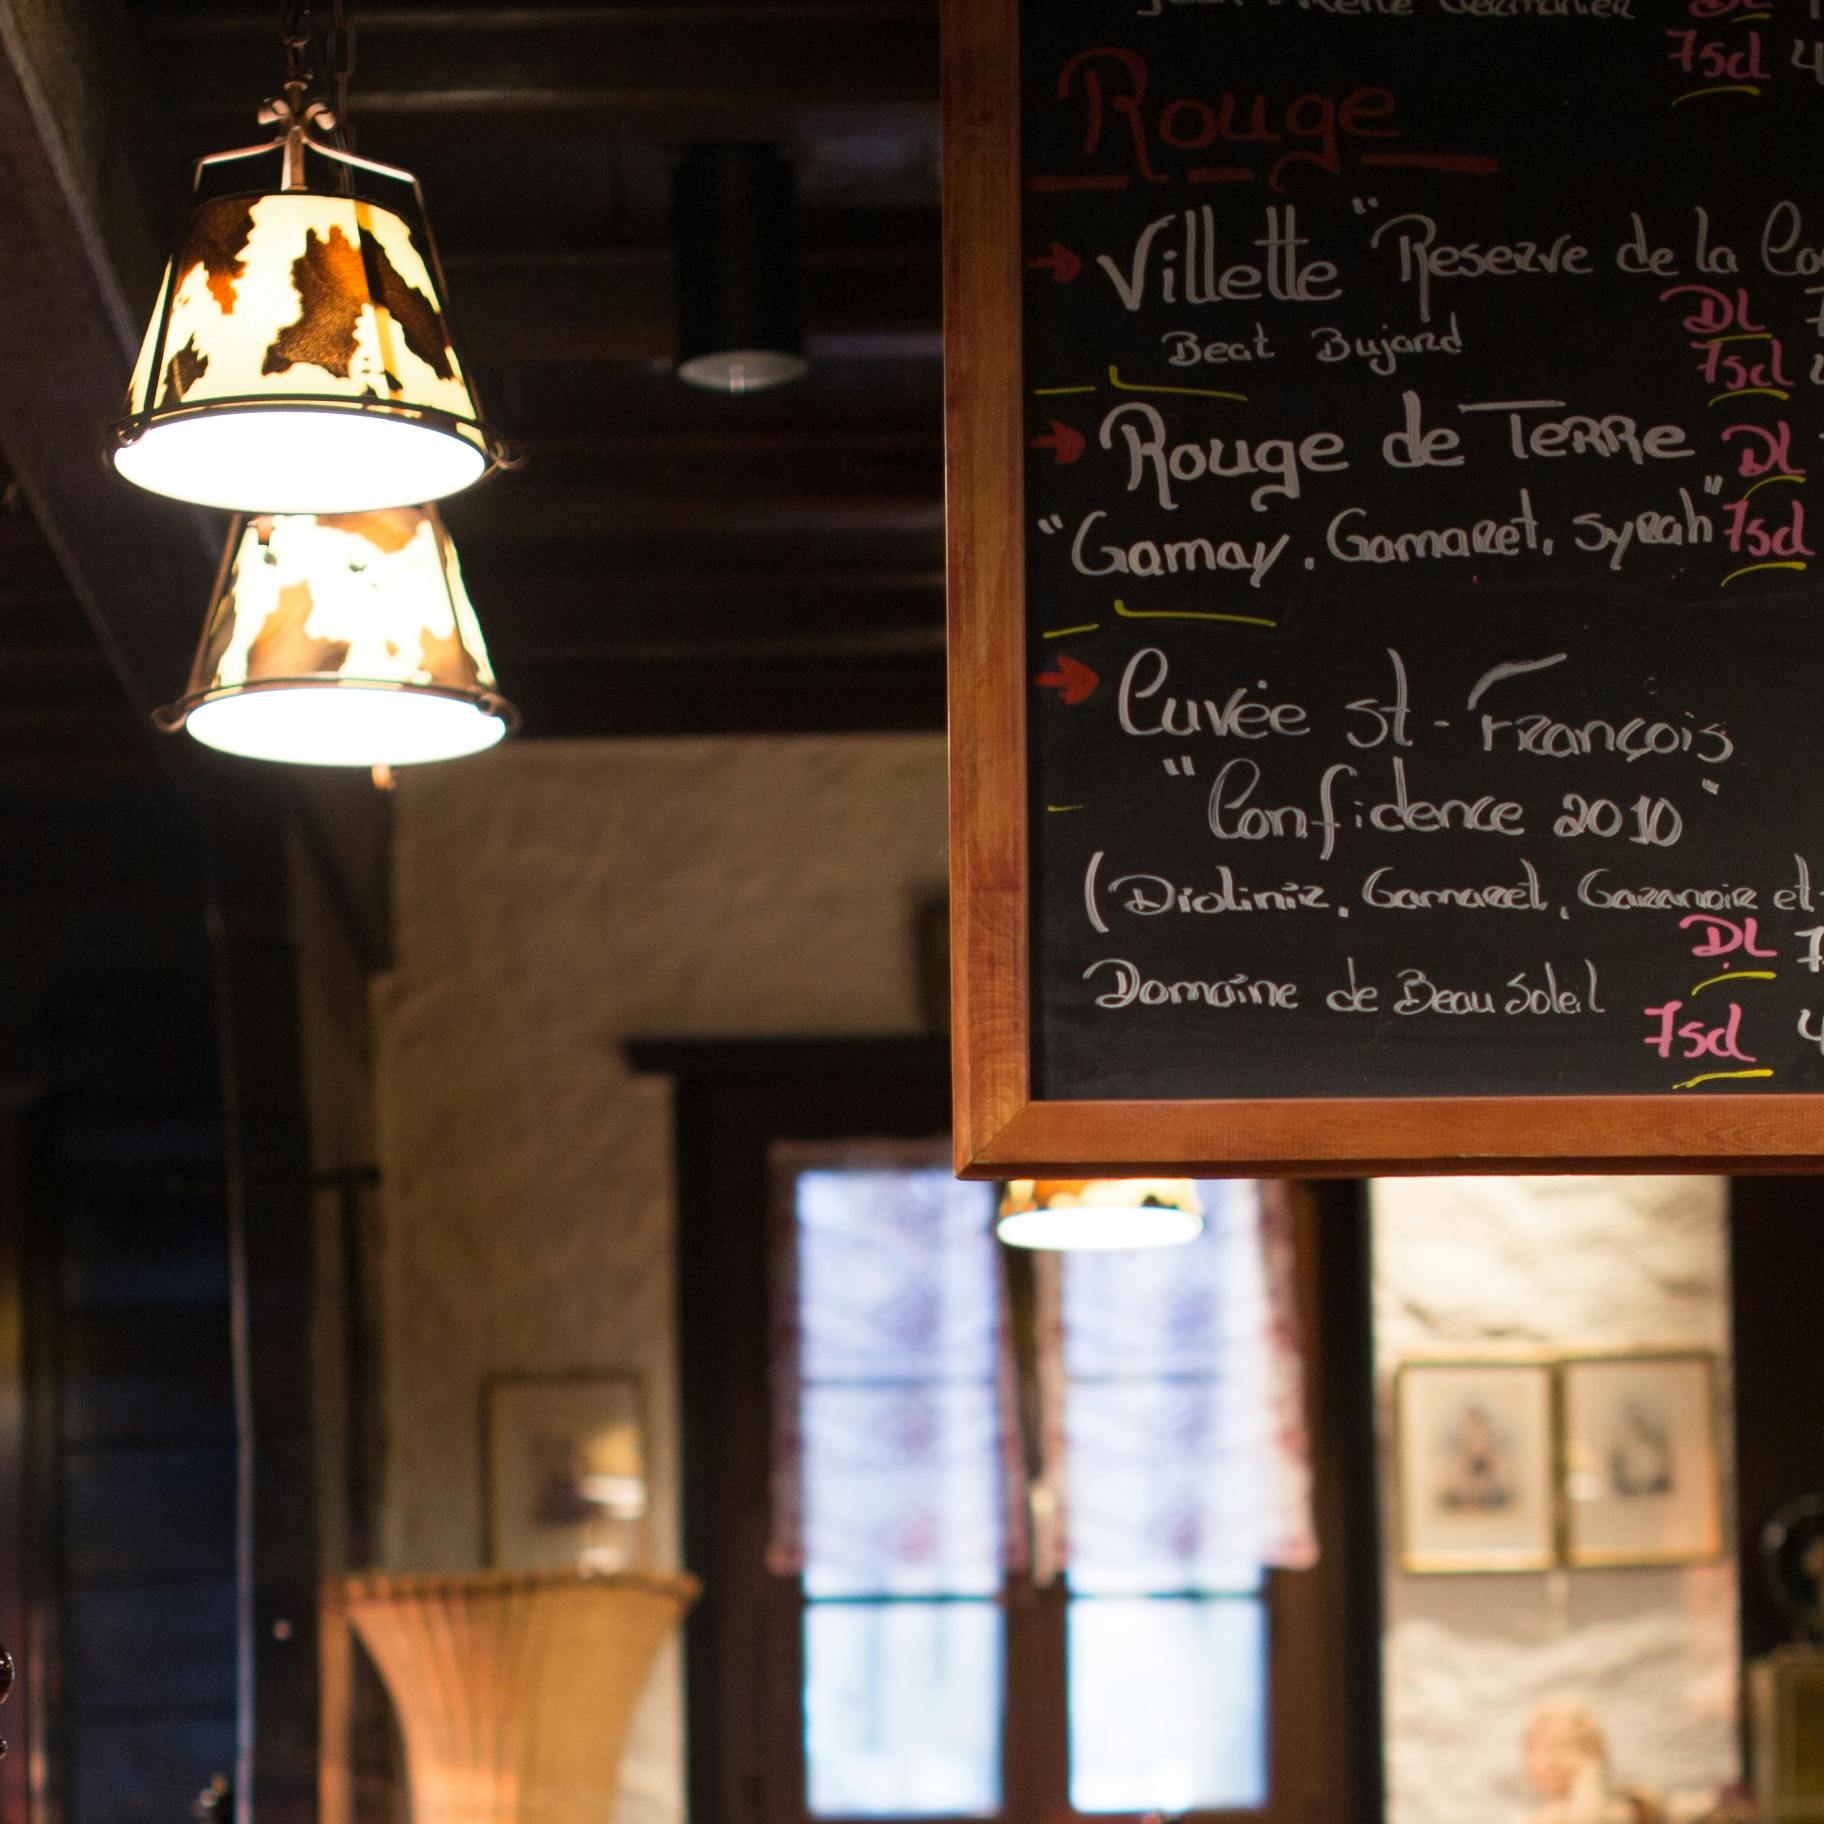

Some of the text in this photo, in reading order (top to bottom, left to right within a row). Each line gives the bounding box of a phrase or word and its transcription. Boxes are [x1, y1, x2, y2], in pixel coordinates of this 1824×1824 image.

[1057, 47, 1400, 193] Rouge
[1097, 205, 1343, 311] Villette
[1616, 212, 1678, 276] de
[1695, 205, 1739, 273] la
[1161, 312, 1462, 375] Beat Bujard
[1099, 402, 1350, 512] Rouge
[1383, 390, 1465, 467] de
[1118, 648, 1310, 738] Cuvée
[1773, 853, 1814, 913] et
[1326, 957, 1379, 1012] de
[1393, 969, 1495, 1015] Beau
[1504, 959, 1605, 1014] Soleil
